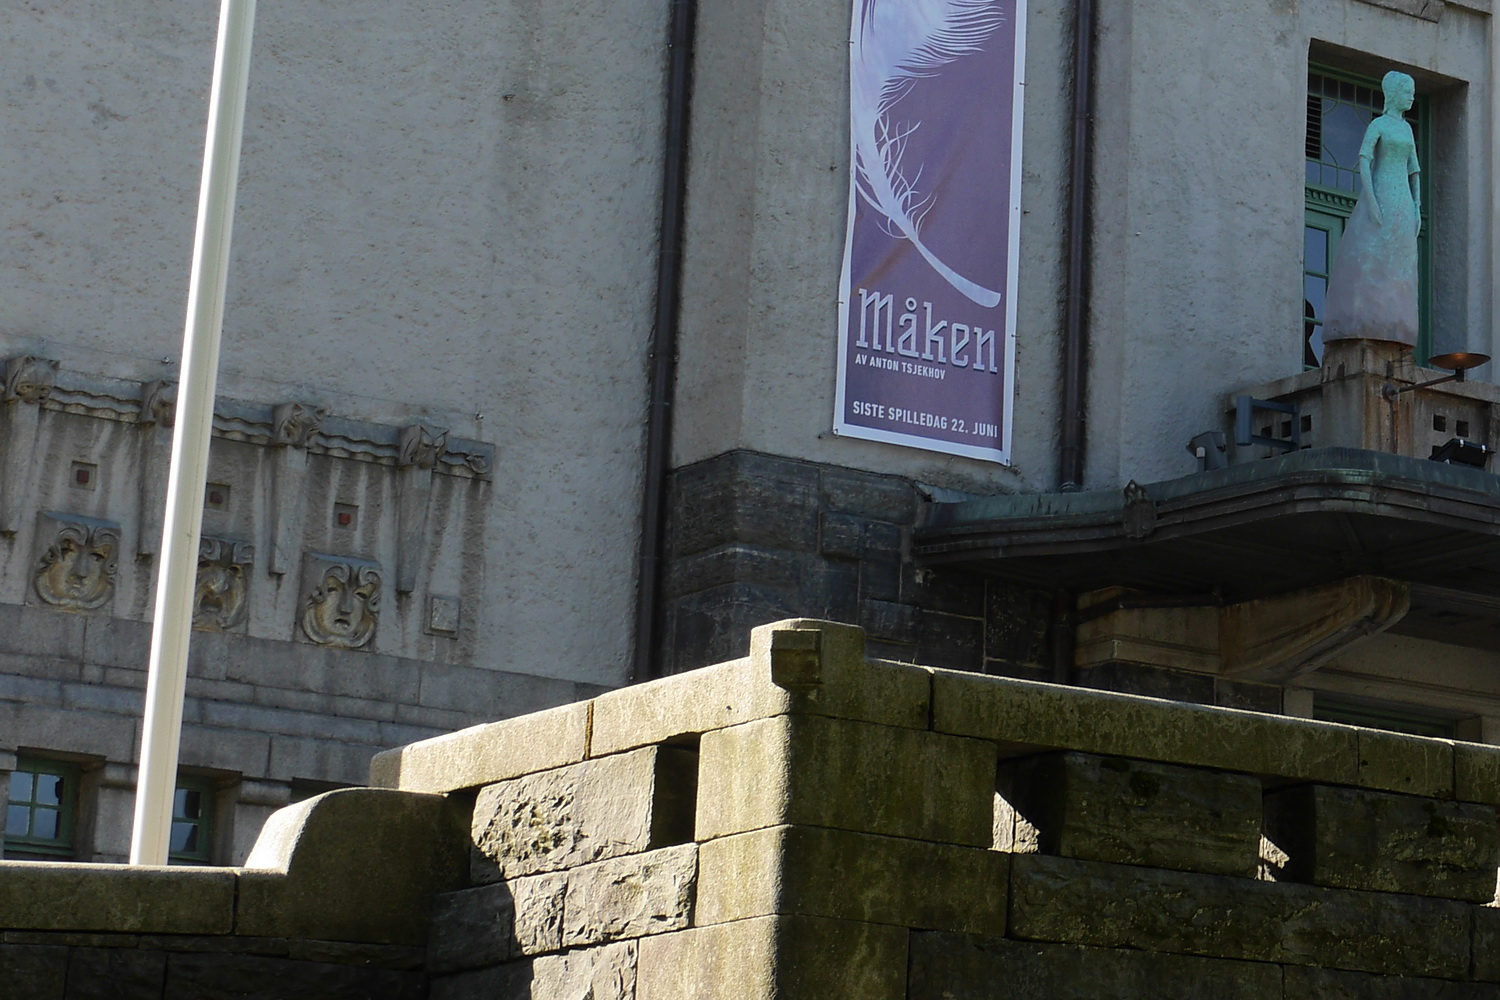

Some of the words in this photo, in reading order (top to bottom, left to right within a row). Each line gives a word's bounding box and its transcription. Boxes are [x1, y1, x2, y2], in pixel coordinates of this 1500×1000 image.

[855, 353, 867, 366] AV
[869, 355, 899, 372] ANTON
[901, 362, 946, 381] TSJEKHOV
[853, 400, 885, 419] SISTE
[888, 407, 948, 430] SPILLEDAG
[951, 418, 969, 434] 22.
[972, 422, 998, 438] JUNI
